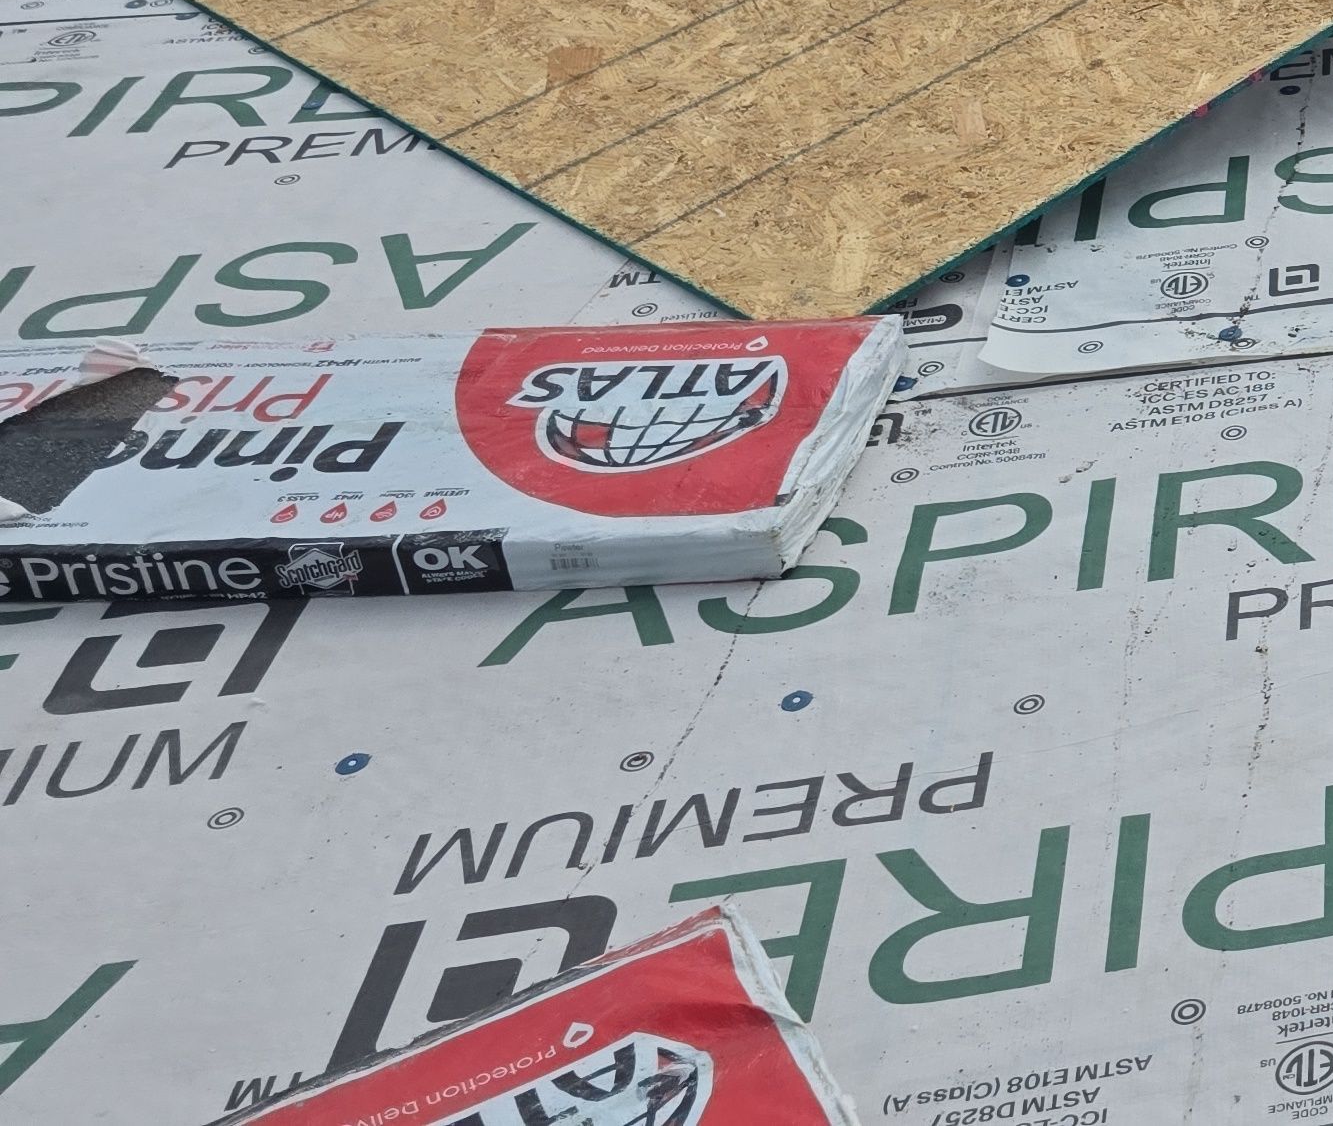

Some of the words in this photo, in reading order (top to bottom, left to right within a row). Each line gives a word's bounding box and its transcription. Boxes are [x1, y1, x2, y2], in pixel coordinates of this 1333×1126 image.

[1162, 258, 1211, 270] Intertek
[609, 271, 662, 289] TM
[1026, 280, 1079, 295] ASTM
[660, 312, 700, 324] Listed
[1170, 304, 1195, 314] CODE
[582, 343, 660, 354] Delivered
[664, 341, 743, 353] Protection
[315, 359, 362, 369] HP42
[521, 360, 774, 403] ATLAS
[1144, 373, 1241, 394] CERTIFIED
[1245, 370, 1277, 382] TO:
[1211, 385, 1242, 398] AC
[1244, 382, 1275, 394] 188
[1110, 417, 1167, 432] ASTM
[1171, 410, 1216, 426] E108
[1219, 402, 1279, 420] (Class
[1282, 397, 1304, 410] A)
[1148, 399, 1205, 416] ASTM
[1207, 393, 1268, 409] D8257
[956, 447, 1021, 461] CCRR-1048
[962, 439, 1017, 453] Intertek
[929, 459, 974, 472] Control
[974, 457, 994, 468] No.
[996, 452, 1046, 465] 5008478
[413, 544, 489, 571] OK
[20, 551, 262, 598] Pristine
[275, 548, 364, 590] Scotchgard
[393, 751, 995, 895] PREMIUM
[1237, 995, 1302, 1015] 5008478
[1304, 990, 1329, 1001] No.
[1075, 1054, 1153, 1081] ASTM
[1259, 1058, 1277, 1068] US
[426, 1044, 558, 1106] Protection
[1006, 1068, 1069, 1093] E108
[917, 1077, 1001, 1105] (Class
[1021, 1086, 1102, 1116] ASTM
[882, 1093, 912, 1116] A)
[931, 1101, 1017, 1126] D8257
[1292, 1106, 1329, 1120] CODE
